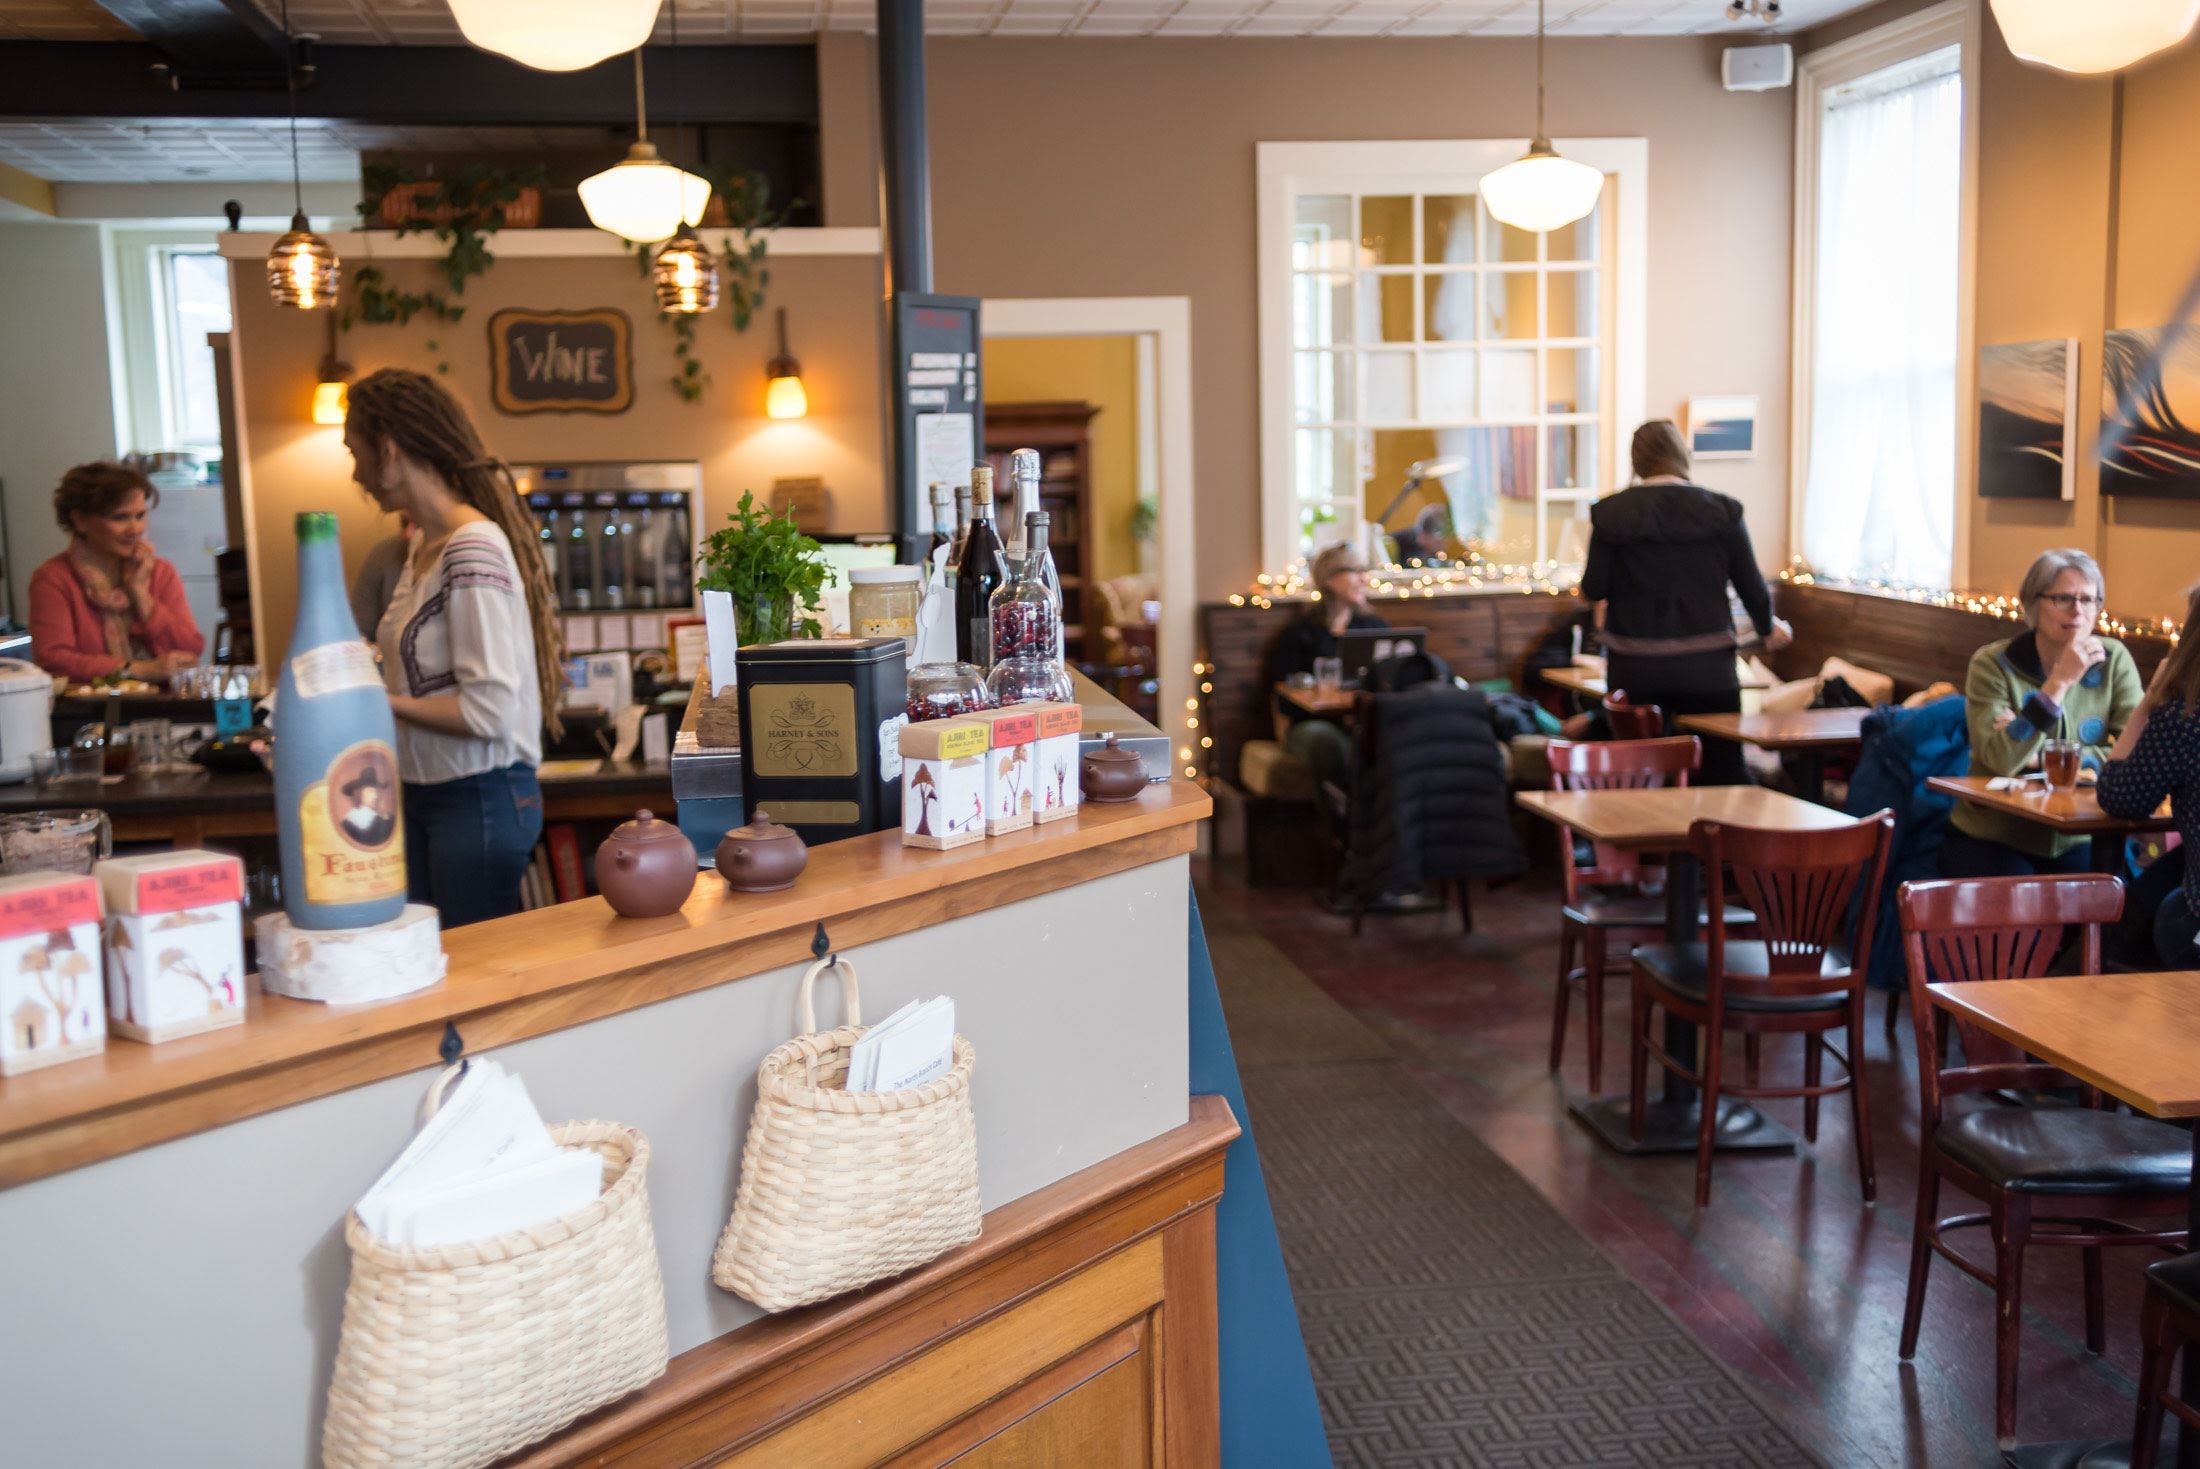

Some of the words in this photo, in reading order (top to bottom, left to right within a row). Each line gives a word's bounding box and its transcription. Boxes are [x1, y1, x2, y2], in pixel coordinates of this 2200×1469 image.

[514, 331, 607, 384] WINE
[768, 730, 804, 738] HARNEY
[807, 730, 815, 738] &
[816, 729, 840, 738] SONS
[970, 729, 984, 739] TEA
